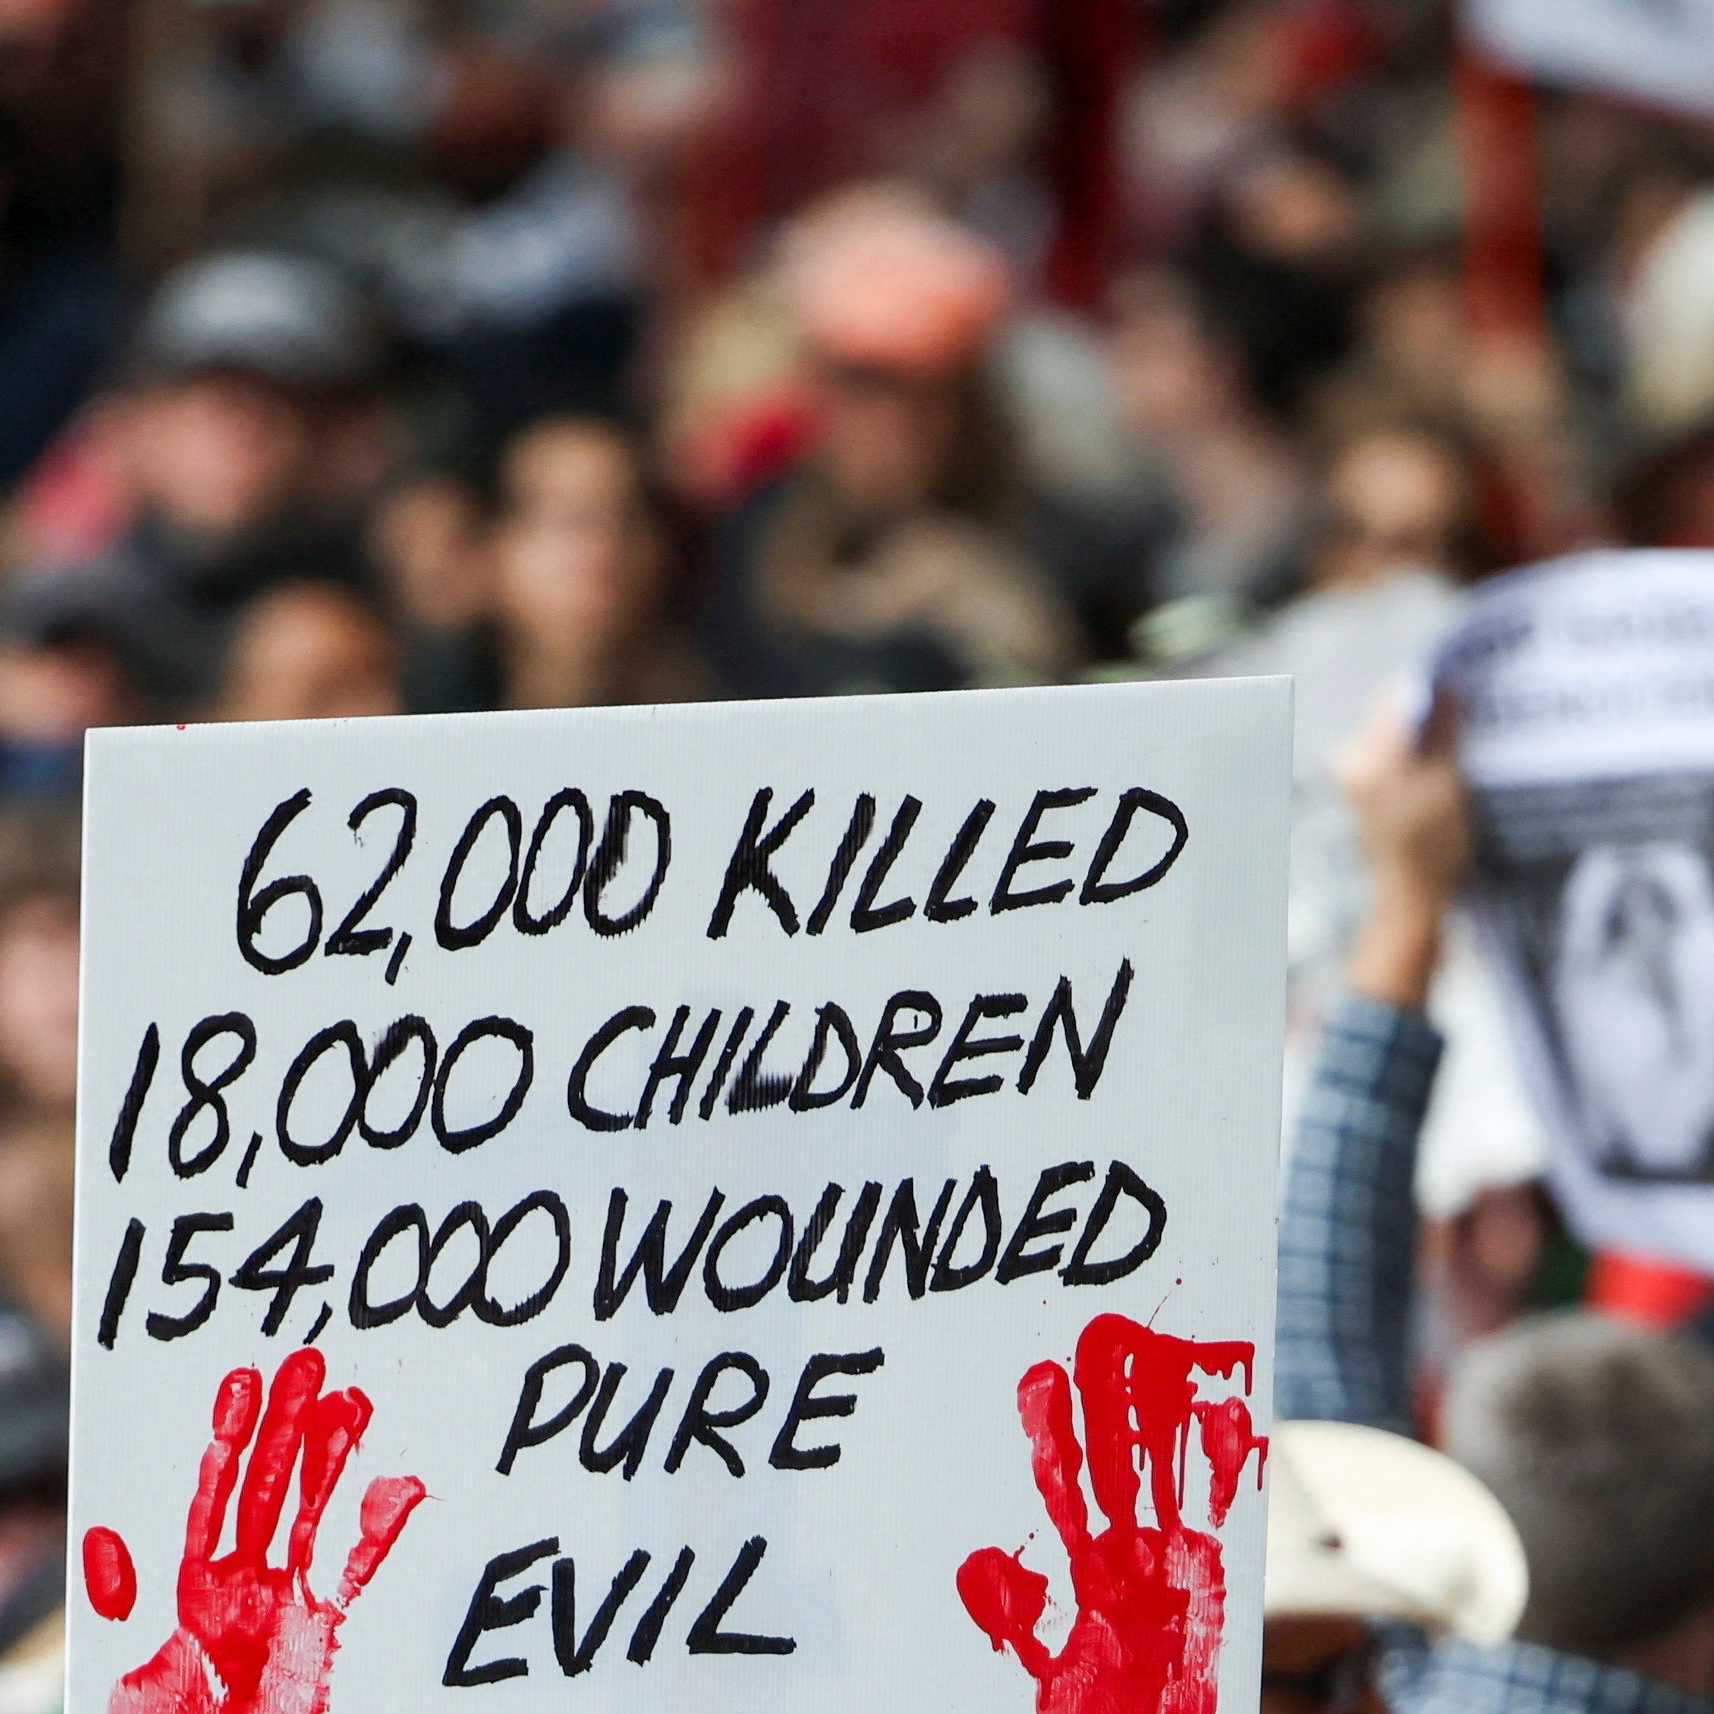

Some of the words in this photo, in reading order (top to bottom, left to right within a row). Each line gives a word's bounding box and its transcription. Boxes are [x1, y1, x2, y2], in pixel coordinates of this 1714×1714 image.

[237, 787, 671, 986] 62,000
[707, 787, 1188, 940] KILLED
[109, 1012, 533, 1188] 18,000
[568, 958, 1134, 1132] CHILDREN
[98, 1190, 571, 1350] 154,000
[594, 1160, 1167, 1321] WOUNDED
[496, 1344, 884, 1482] PURE
[442, 1536, 796, 1687] EVIL
